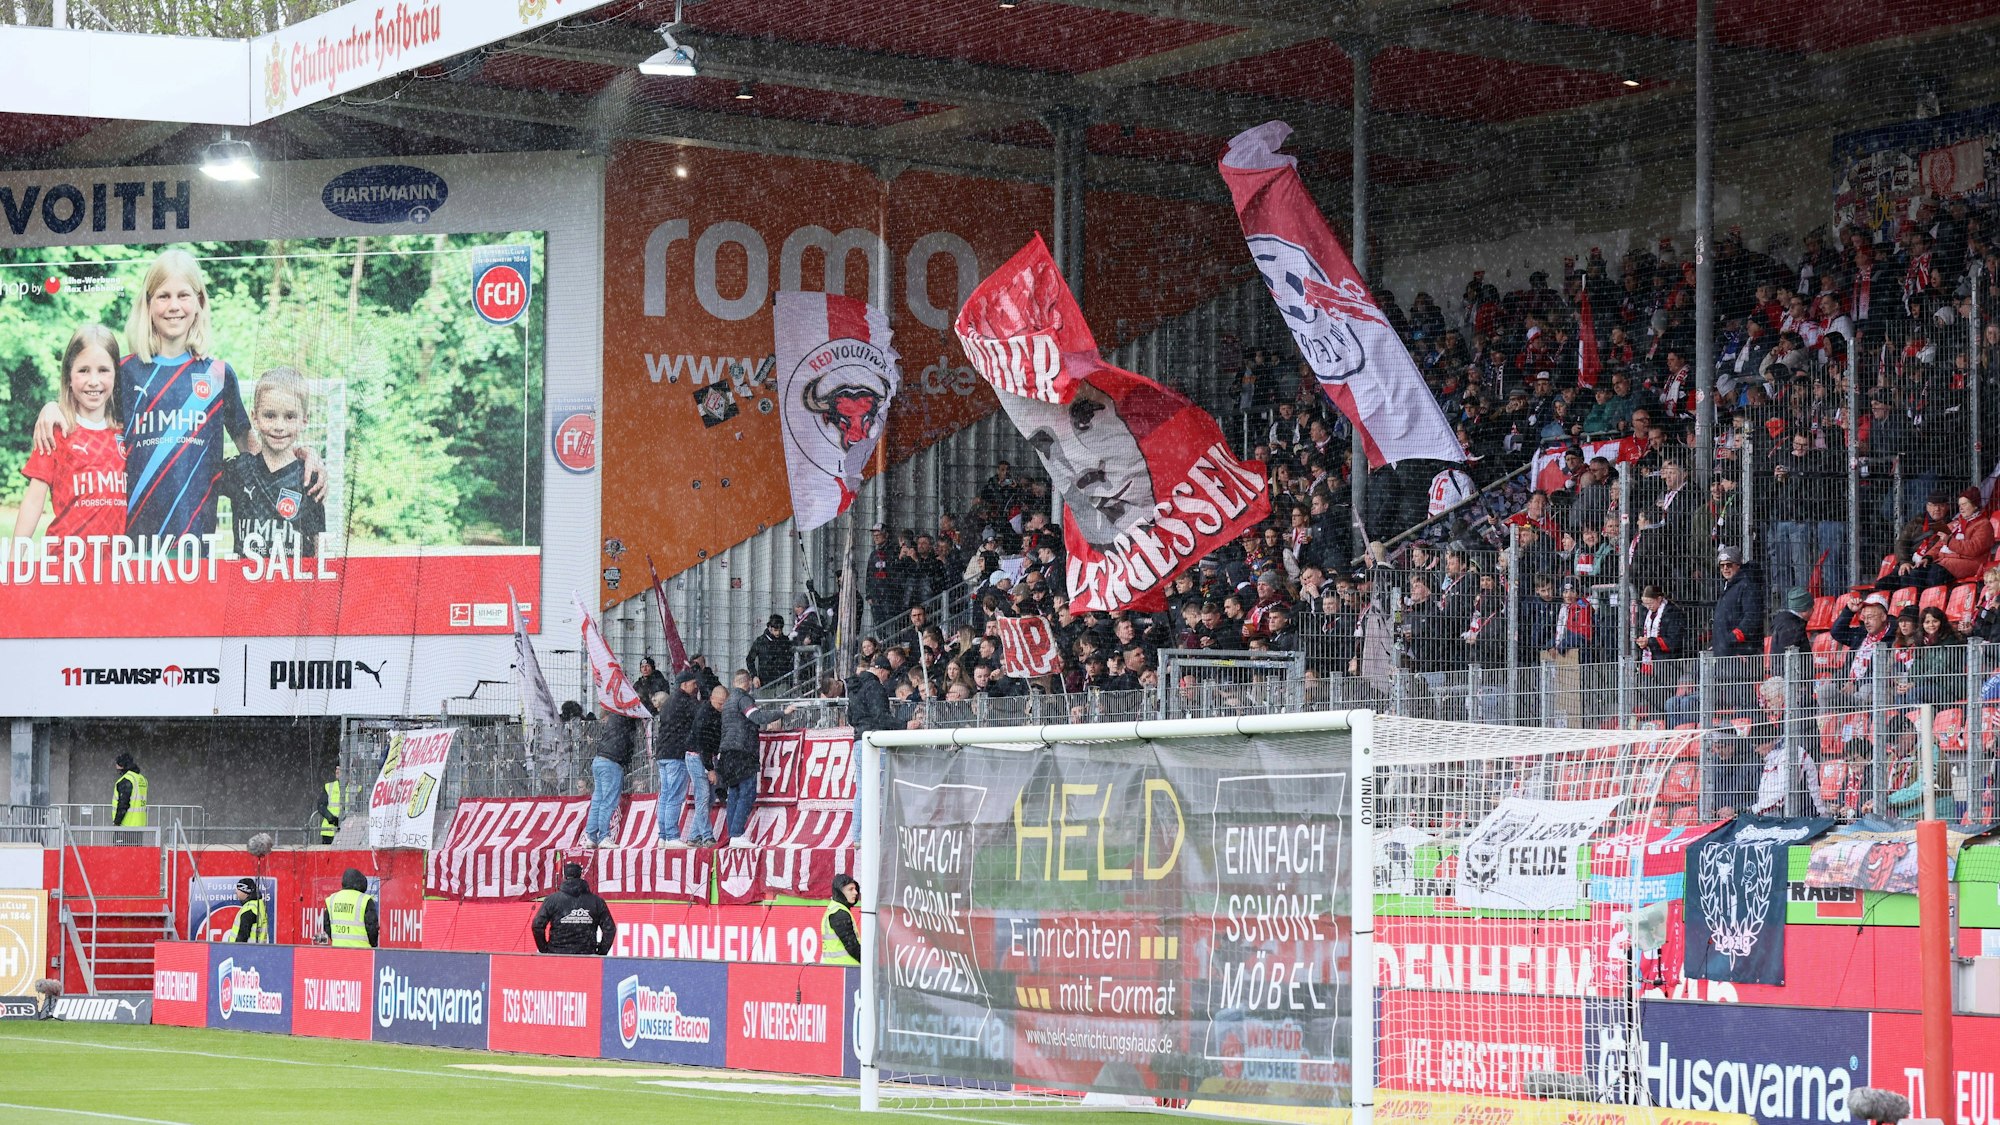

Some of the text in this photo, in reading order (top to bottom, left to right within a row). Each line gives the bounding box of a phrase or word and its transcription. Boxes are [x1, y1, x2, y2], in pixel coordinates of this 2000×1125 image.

[290, 0, 441, 97] Stuttgarter Hofbräu
[0, 180, 191, 235] VOITH
[333, 183, 437, 203] HARTMANN
[32, 283, 42, 294] by
[64, 284, 125, 293] Max Liebhaber
[484, 282, 519, 306] FCH
[643, 219, 979, 331] roma
[142, 436, 174, 447] PORSCHE
[176, 435, 205, 447] COMPANY
[158, 410, 207, 432] MHP
[998, 616, 1052, 677] RIP
[269, 660, 352, 690] PUMA
[1361, 775, 1373, 826] VINDICO
[899, 825, 963, 874] EINFACH
[1014, 778, 1185, 881] HELD
[1225, 823, 1326, 875] EINFACH
[334, 902, 355, 914] SECURITY
[902, 880, 965, 935] SCHÖNE
[1787, 881, 1856, 902] RAUB
[11, 912, 31, 920] 1846
[403, 909, 422, 942] MH
[570, 908, 590, 917] SDS
[1227, 883, 1326, 943] SCHÖNE
[608, 923, 777, 963] EIDENHEIM
[1011, 918, 1131, 959] Einrichten
[894, 936, 979, 994] KÜCHEN
[1219, 950, 1327, 1011] MÖBEL
[155, 970, 198, 1002] HEIDENHEIM
[233, 993, 256, 1009] UNSERE
[304, 978, 361, 1013] TSV LANGENAU
[396, 975, 483, 1031] Husqvarna
[1059, 976, 1176, 1016] mit Format
[52, 998, 119, 1020] PUMA
[503, 988, 588, 1028] TSG SCHNAITHEIM
[639, 1015, 709, 1039] UNSERE REGION
[743, 1001, 827, 1043] SV NERESHEIM
[1025, 1027, 1173, 1055] www.held-einrichtungshaus.de
[1405, 1037, 1436, 1086] VFL
[1953, 1070, 2000, 1125] EUL
